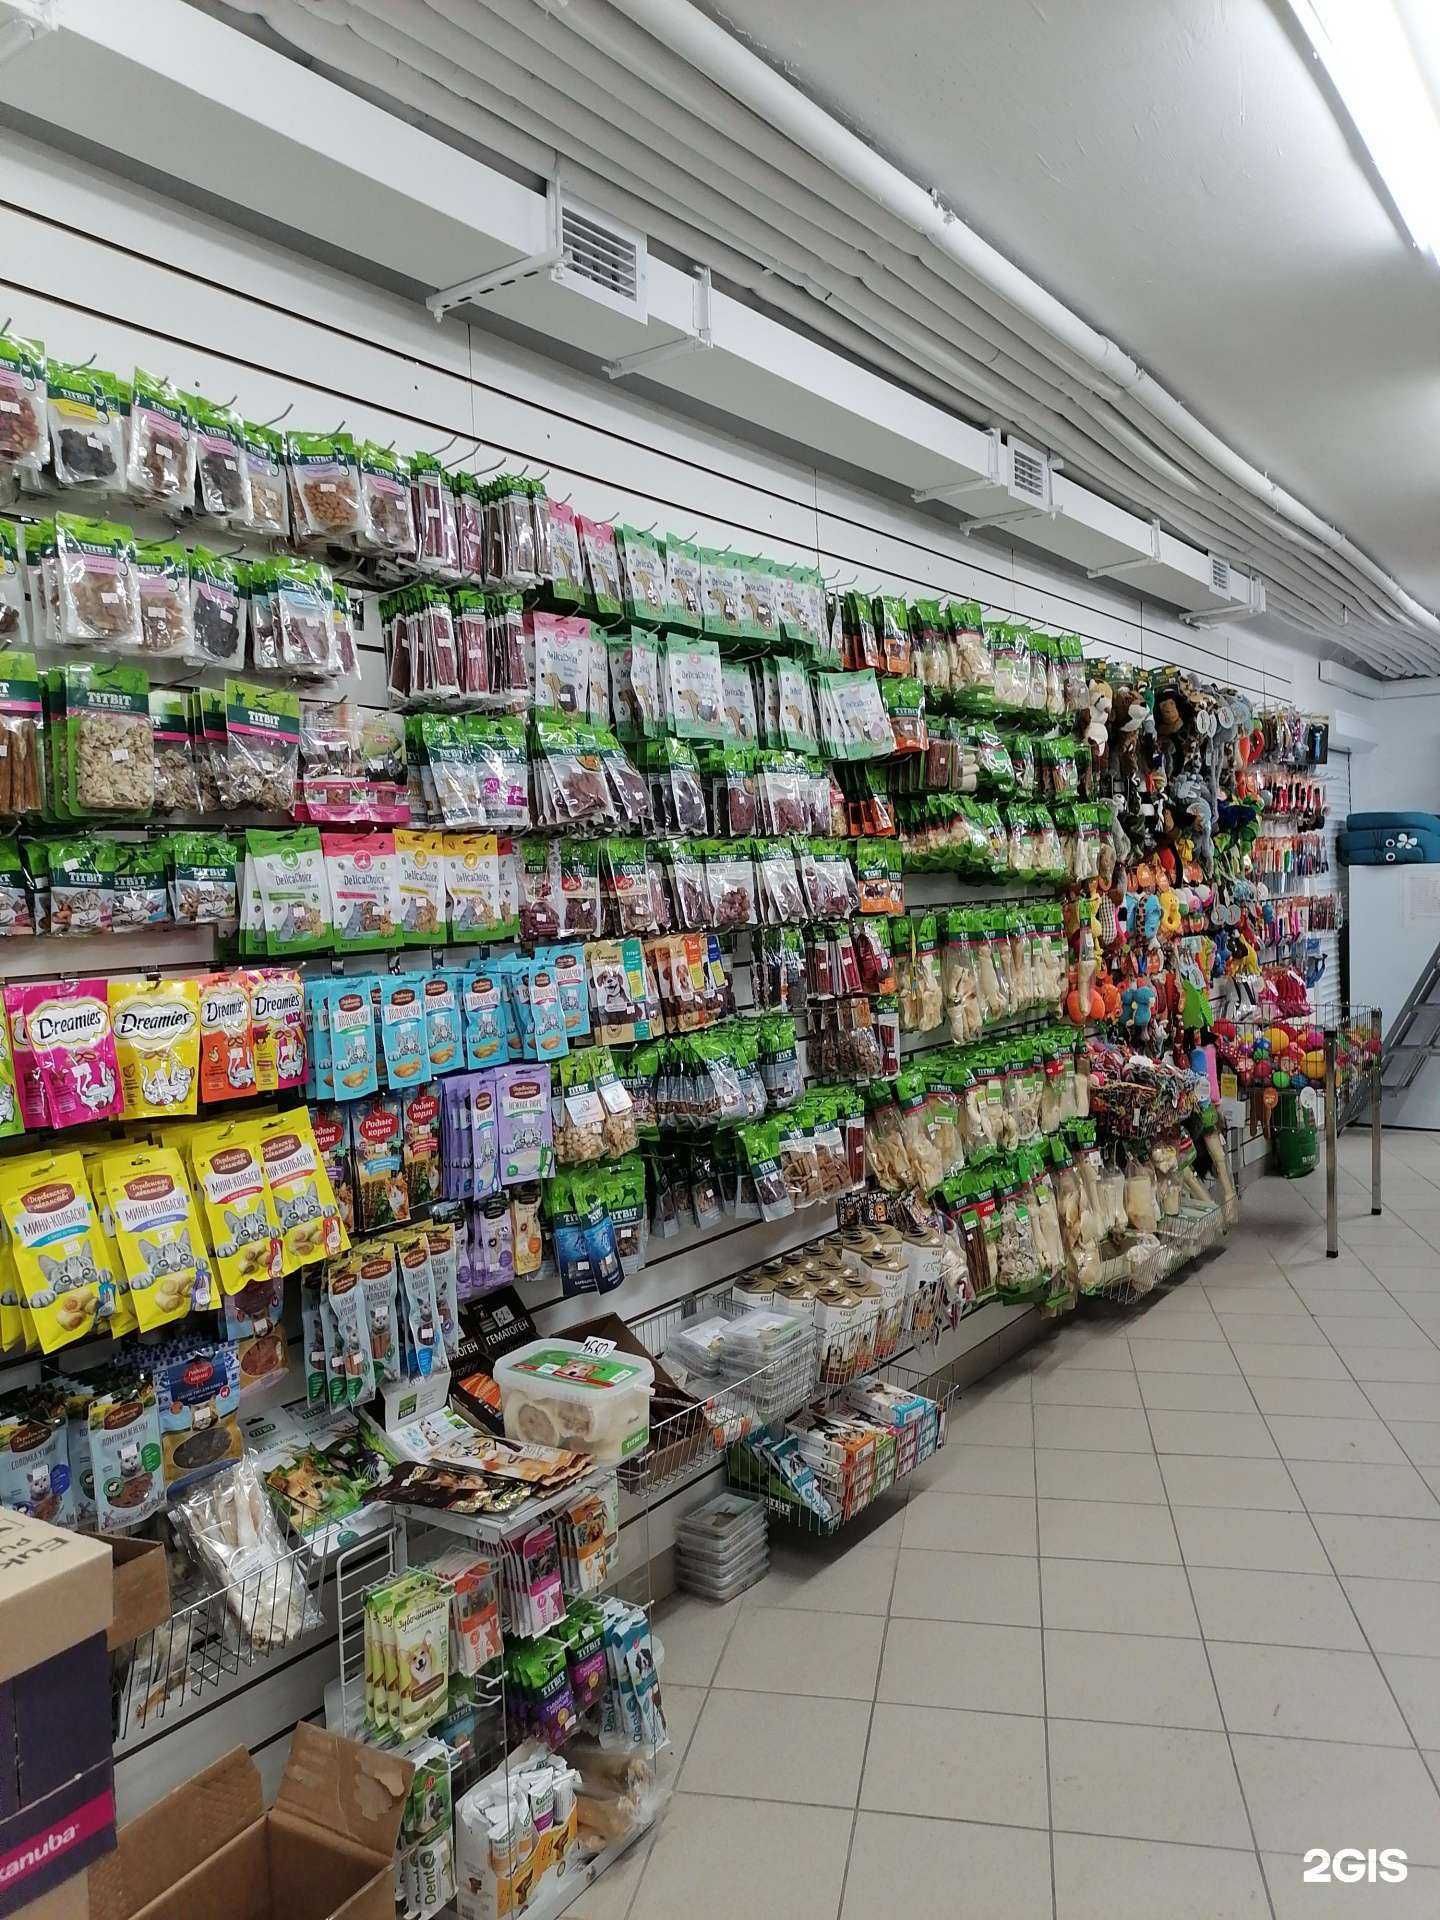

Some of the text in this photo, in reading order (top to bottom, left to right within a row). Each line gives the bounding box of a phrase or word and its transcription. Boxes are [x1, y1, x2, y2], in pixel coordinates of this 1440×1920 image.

[255, 994, 299, 1015] Dreamies
[38, 1010, 101, 1039] Dreamies
[121, 1011, 189, 1033] Dreamies
[412, 1100, 435, 1112] Родные
[365, 1118, 393, 1129] Родные
[368, 1127, 391, 1138] корма
[316, 1135, 335, 1146] орма
[125, 1198, 187, 1221] МИНИ-КОЛБАСКИ
[23, 1206, 86, 1237] МИНИ-КОЛБАСКИ
[485, 1320, 529, 1346] ГЕМАТОГЕН
[424, 1868, 437, 1905] Dent
